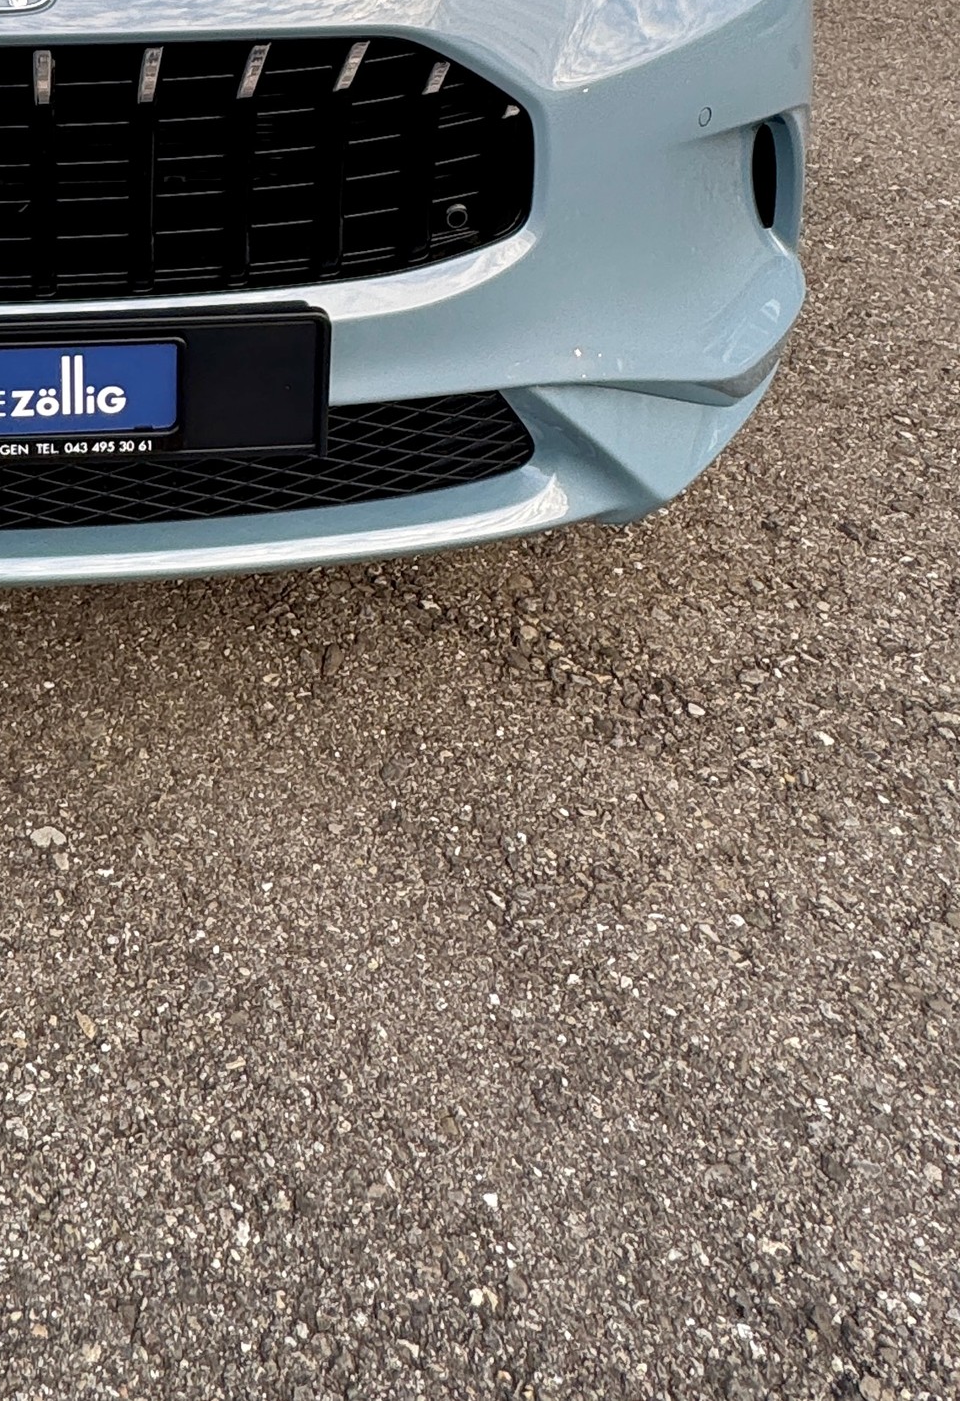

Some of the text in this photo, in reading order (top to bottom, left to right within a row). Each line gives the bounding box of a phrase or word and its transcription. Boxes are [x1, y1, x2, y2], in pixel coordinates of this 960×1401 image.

[64, 441, 88, 454] 043
[92, 441, 115, 453] 495
[119, 440, 135, 452] 30
[138, 439, 152, 452] 61
